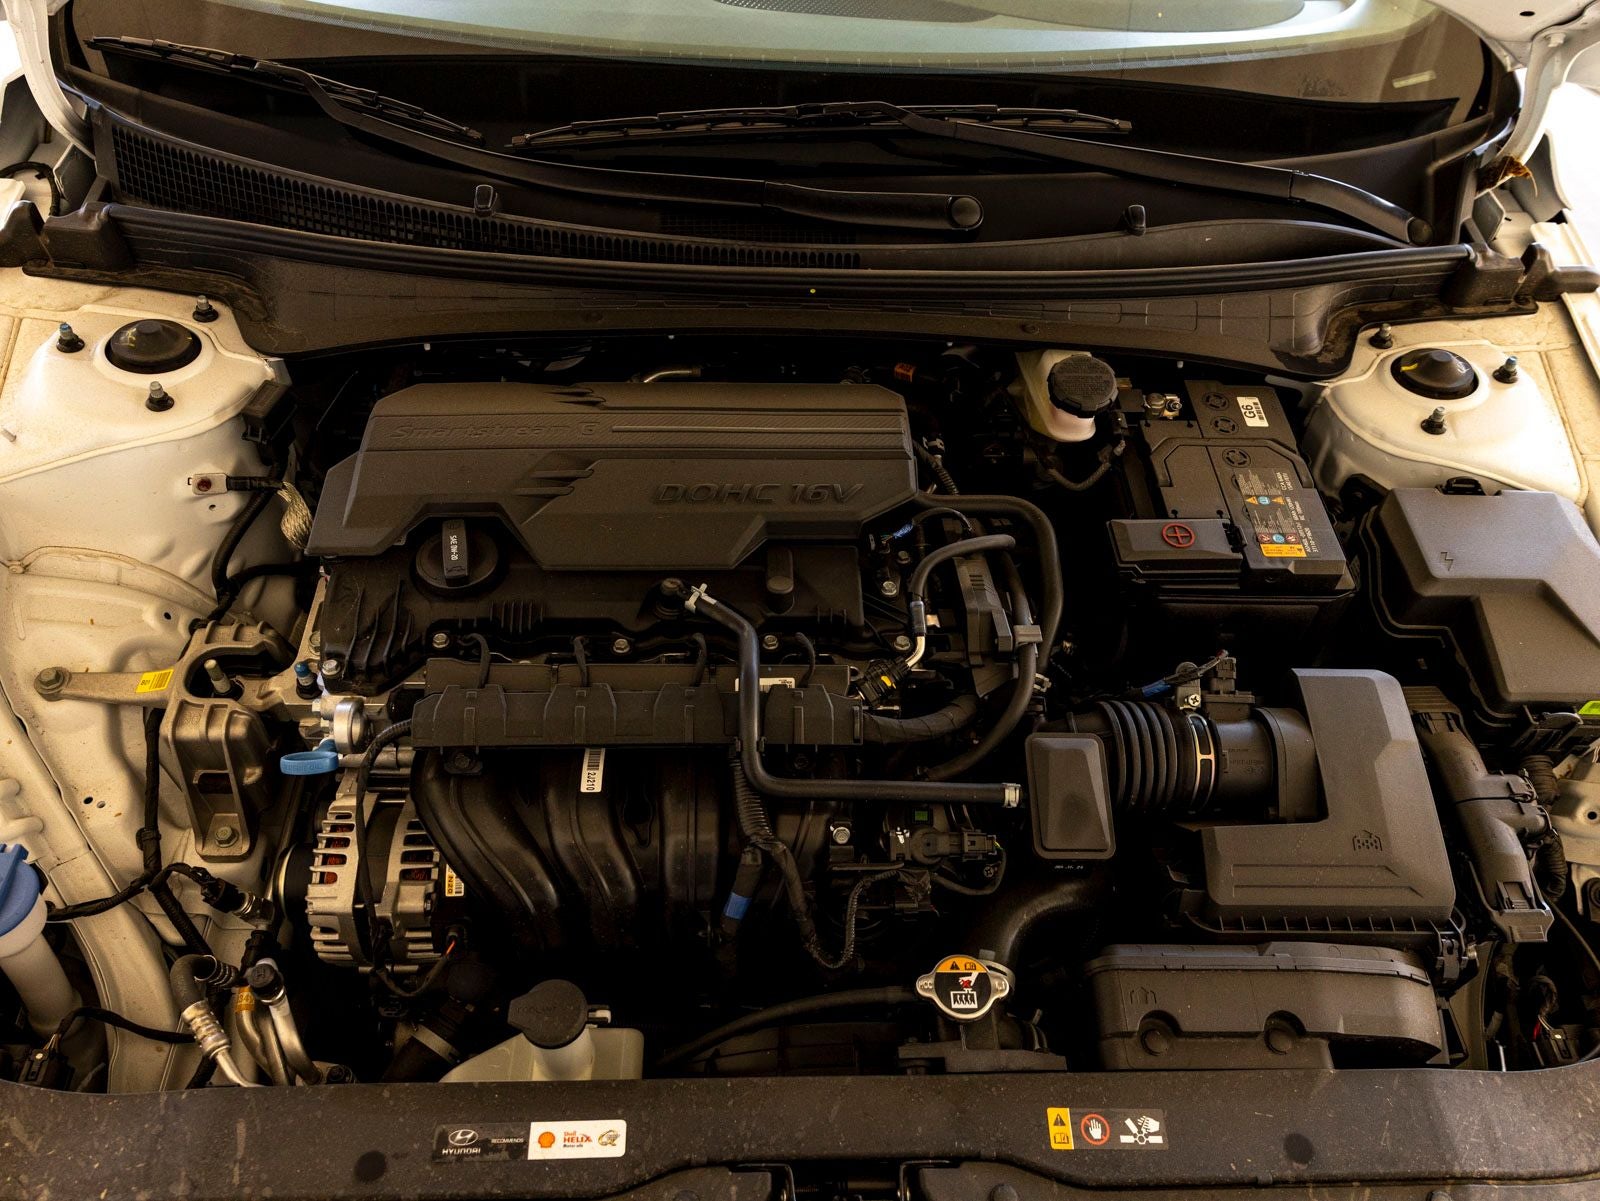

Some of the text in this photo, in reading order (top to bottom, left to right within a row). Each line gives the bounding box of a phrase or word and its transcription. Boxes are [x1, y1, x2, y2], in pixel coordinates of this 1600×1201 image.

[1241, 404, 1256, 419] G6
[654, 482, 864, 505] DOHC 16V
[449, 534, 459, 561] SAE 0W-20
[563, 1135, 593, 1143] HELIX
[441, 1147, 481, 1156] HYUNDAI
